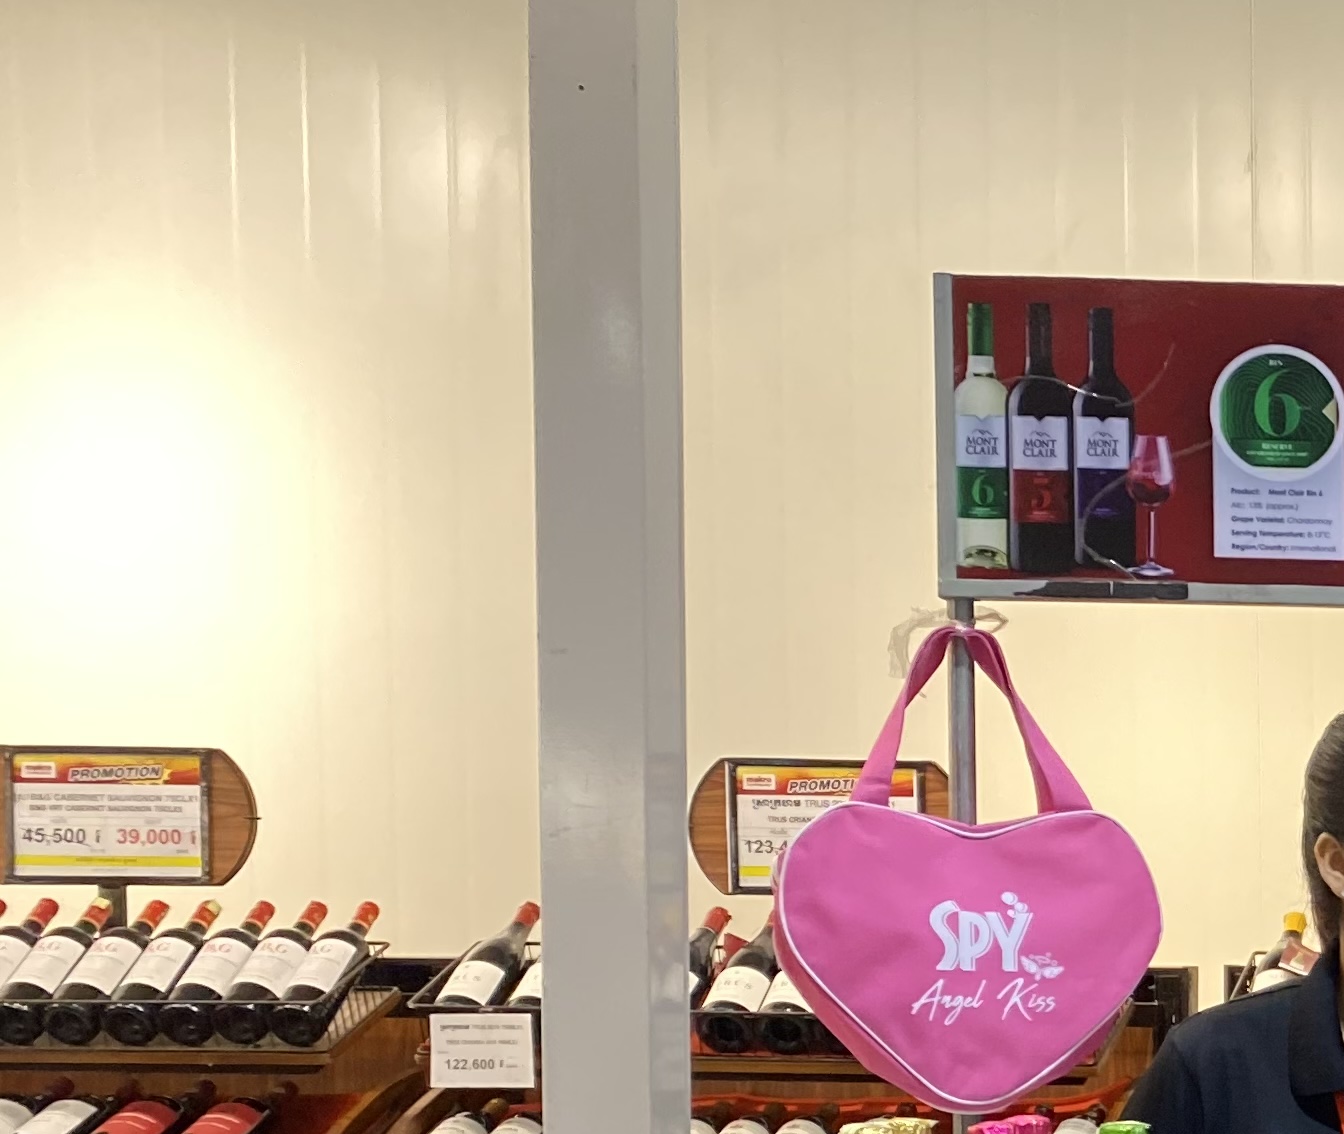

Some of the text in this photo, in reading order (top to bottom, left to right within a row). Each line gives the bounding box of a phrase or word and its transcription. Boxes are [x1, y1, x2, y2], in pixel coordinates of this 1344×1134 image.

[1254, 369, 1301, 437] 6
[966, 437, 999, 446] MONT
[1023, 438, 1057, 448] MONT
[1087, 438, 1119, 448] MONT
[966, 446, 999, 456] CLAIR
[1023, 448, 1057, 458] CLAIR
[1086, 447, 1119, 457] CLAIR
[971, 475, 994, 506] 6
[70, 766, 161, 780] PROMOTION
[789, 779, 856, 792] PROMOTI
[22, 828, 182, 846] 45,500 39,000
[745, 840, 787, 855] 123,4
[929, 898, 1034, 972] SPY
[911, 978, 1056, 1025] Angel Kiss
